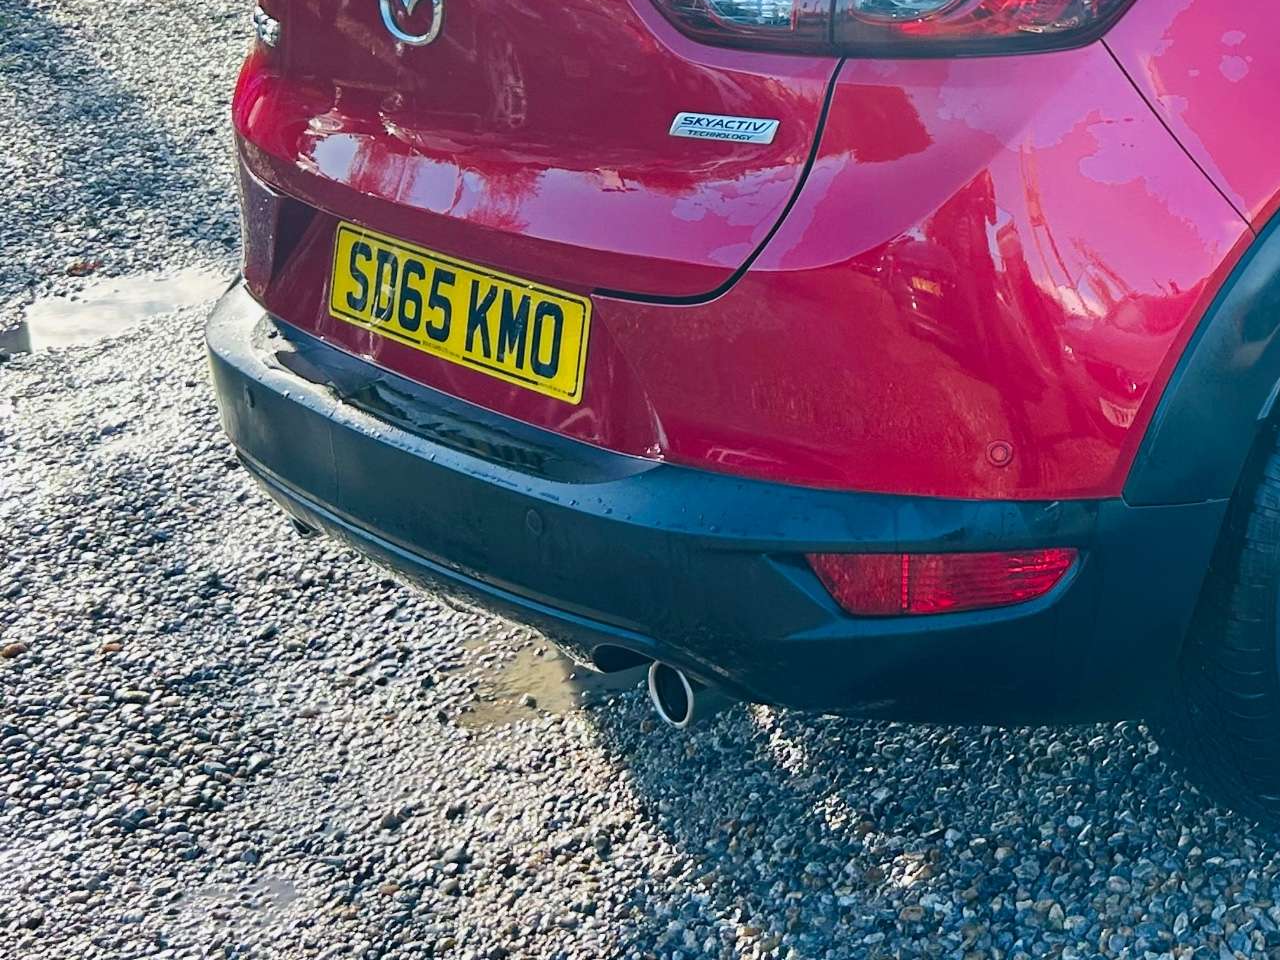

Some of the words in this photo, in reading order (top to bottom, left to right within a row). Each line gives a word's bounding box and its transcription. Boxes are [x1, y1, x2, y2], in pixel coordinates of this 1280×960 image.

[681, 116, 766, 131] SKYACTIV
[687, 129, 753, 140] TECHNOLOGY
[346, 241, 456, 343] SD65
[465, 279, 565, 379] KMO
